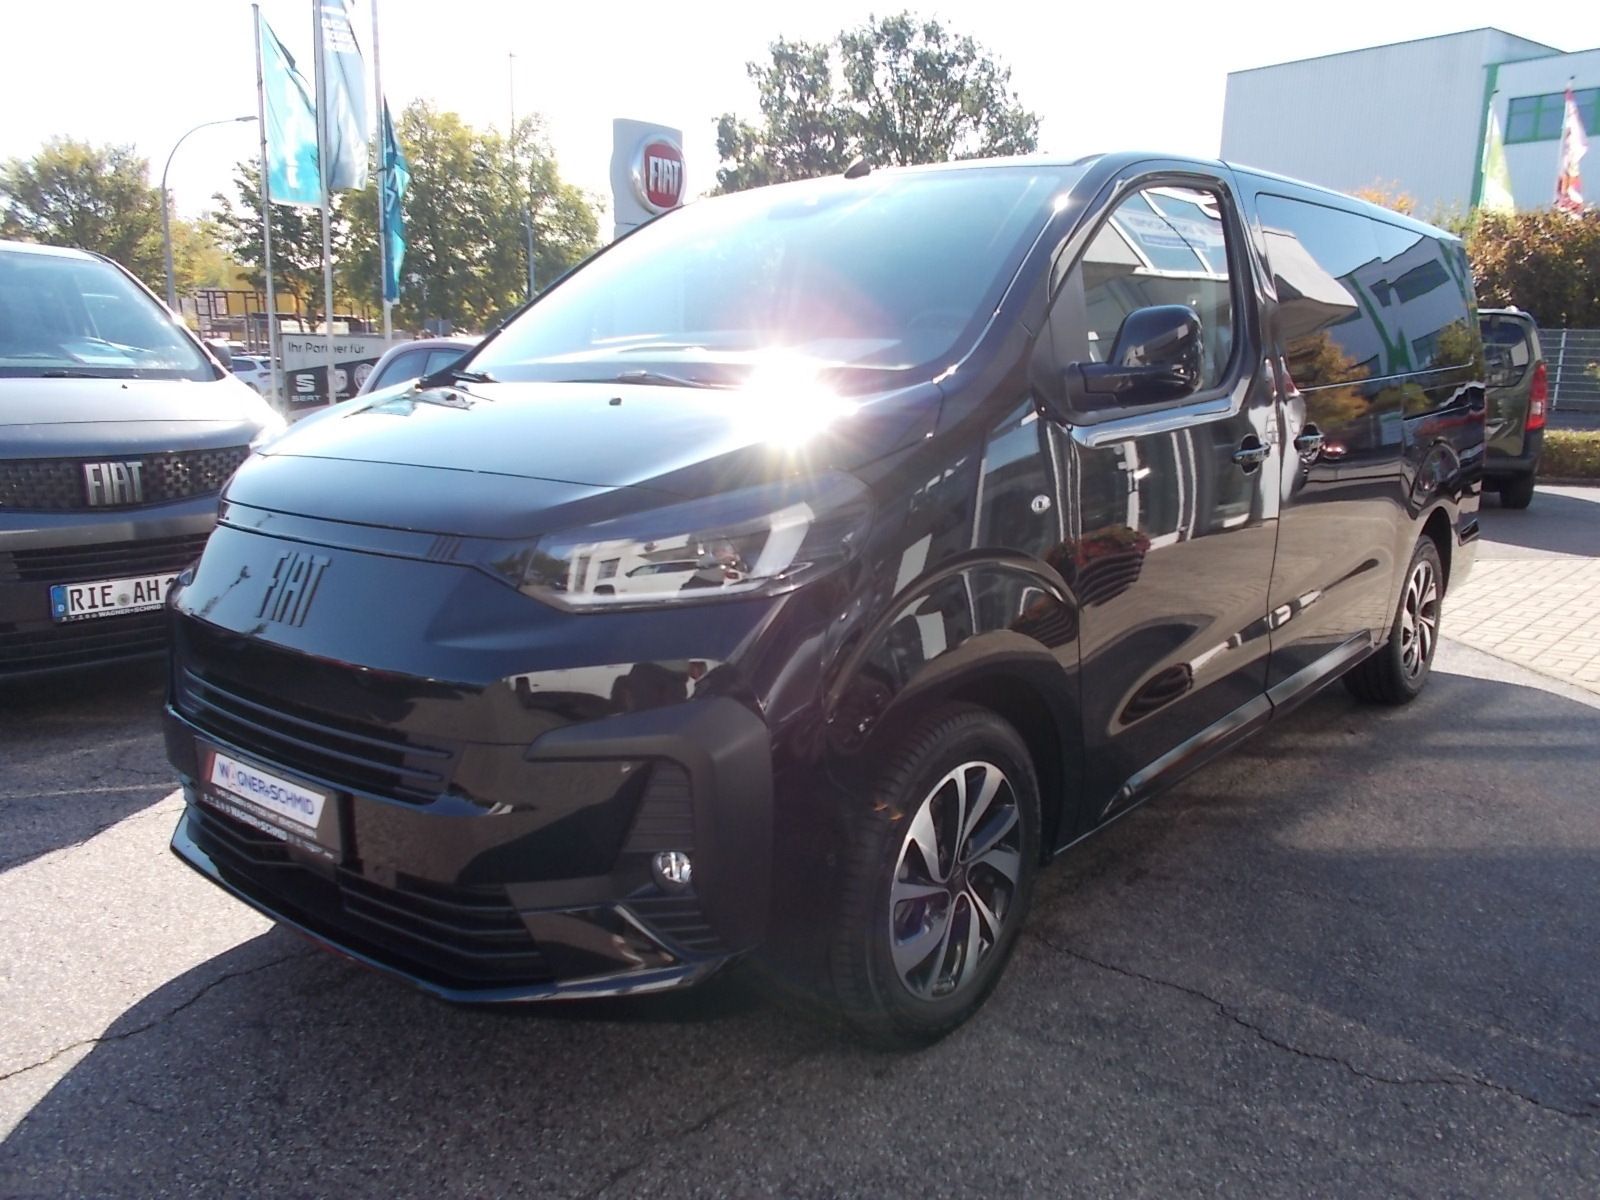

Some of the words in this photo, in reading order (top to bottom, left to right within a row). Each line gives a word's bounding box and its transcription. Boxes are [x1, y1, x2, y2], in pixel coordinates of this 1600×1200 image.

[649, 155, 681, 197] FIAT
[288, 342, 302, 352] Ihr
[350, 343, 365, 354] für
[84, 461, 143, 505] FIAT
[69, 585, 115, 611] RIE
[257, 551, 333, 628] FIAT
